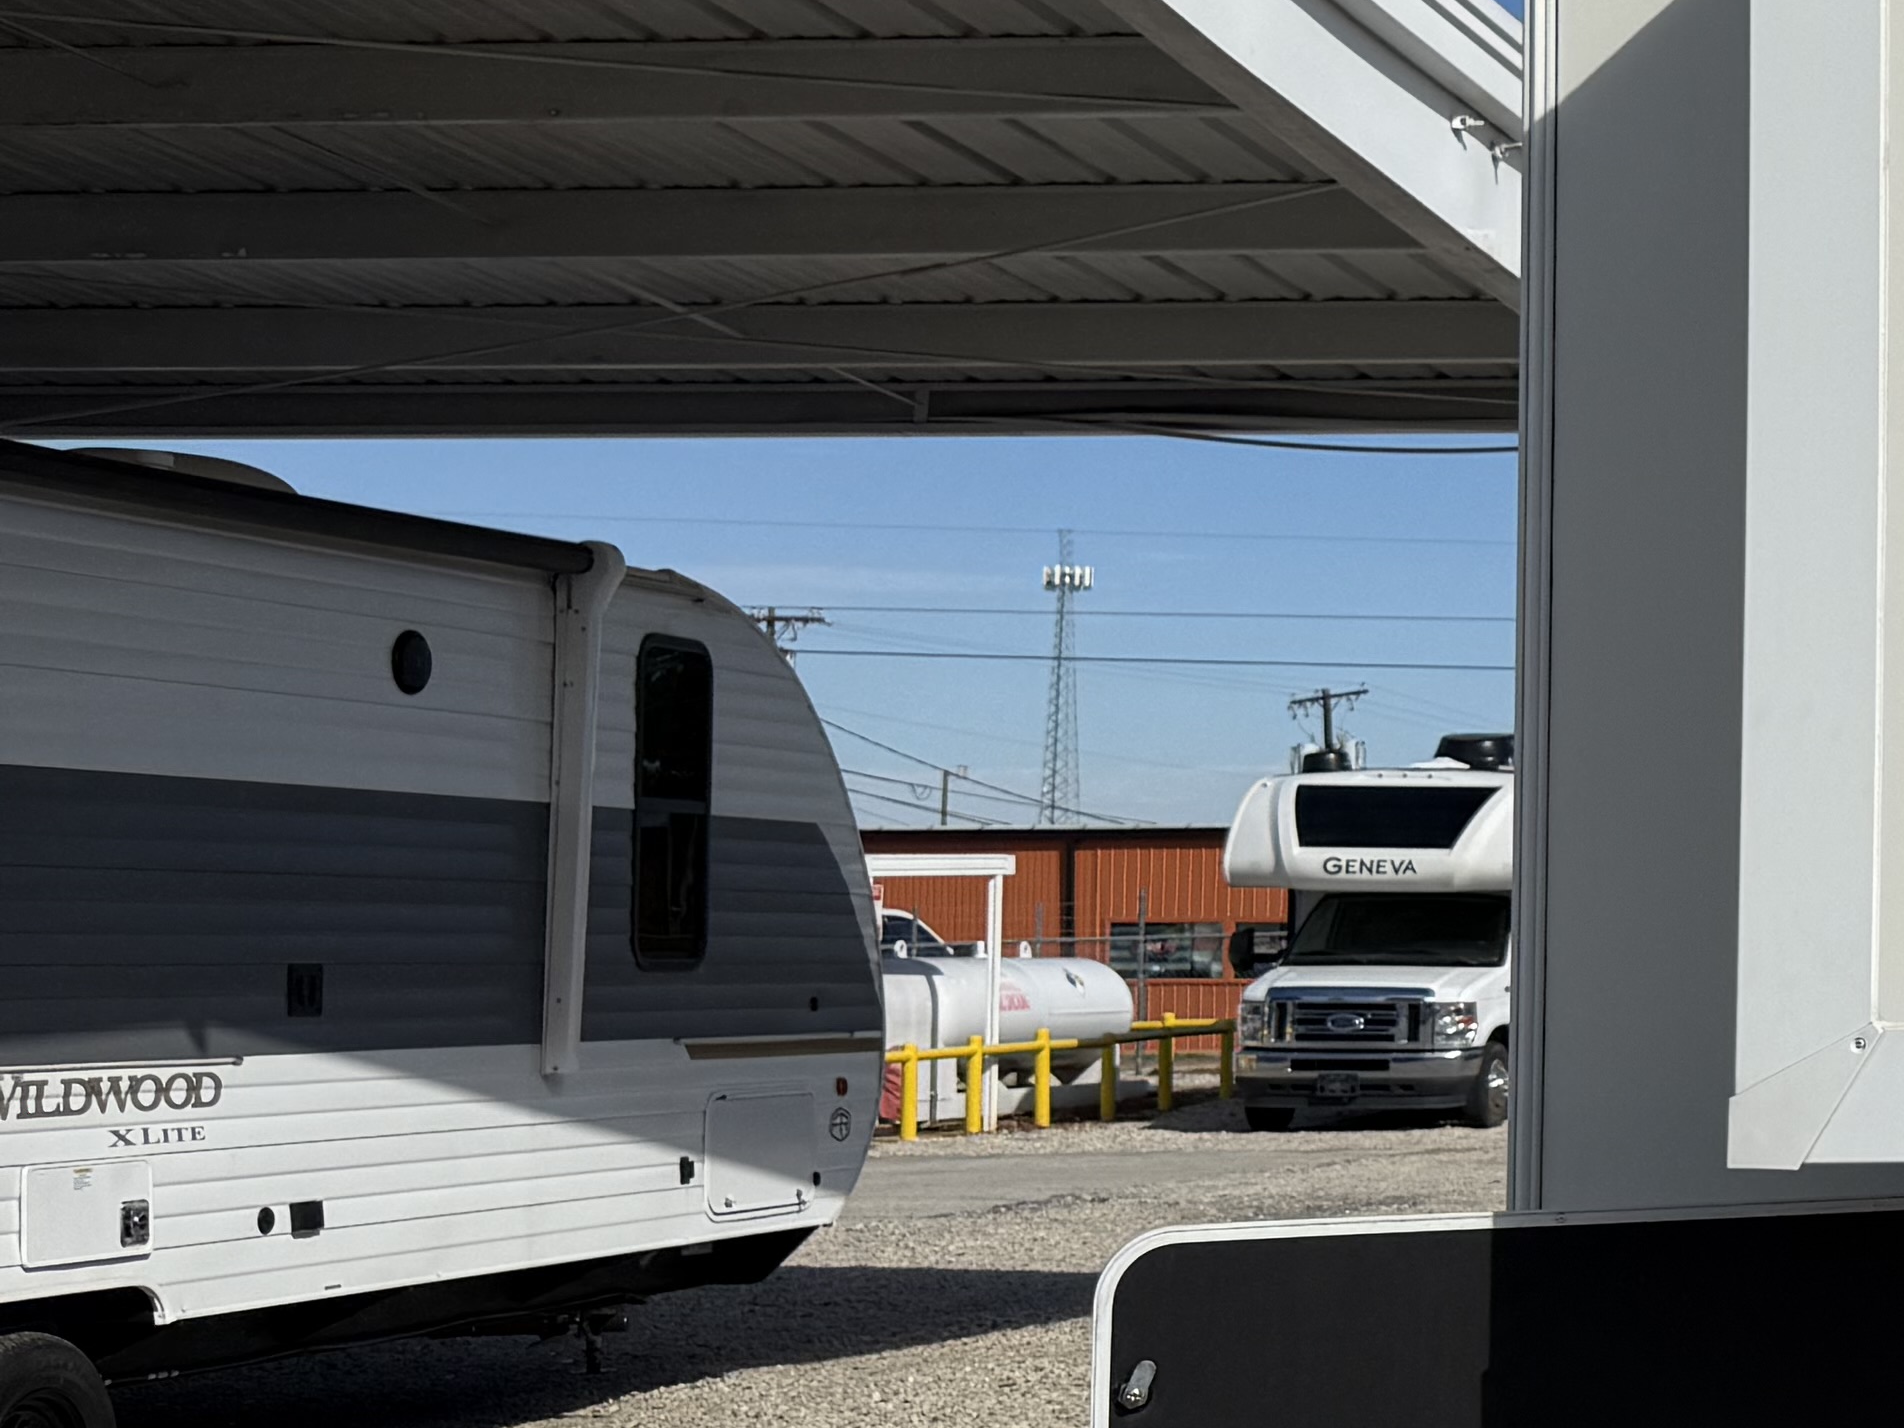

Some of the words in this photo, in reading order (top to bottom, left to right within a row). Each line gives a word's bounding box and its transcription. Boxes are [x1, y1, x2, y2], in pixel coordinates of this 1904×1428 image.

[1322, 856, 1417, 876] GENEVA
[108, 1128, 136, 1148] X
[141, 1125, 206, 1146] LITE
